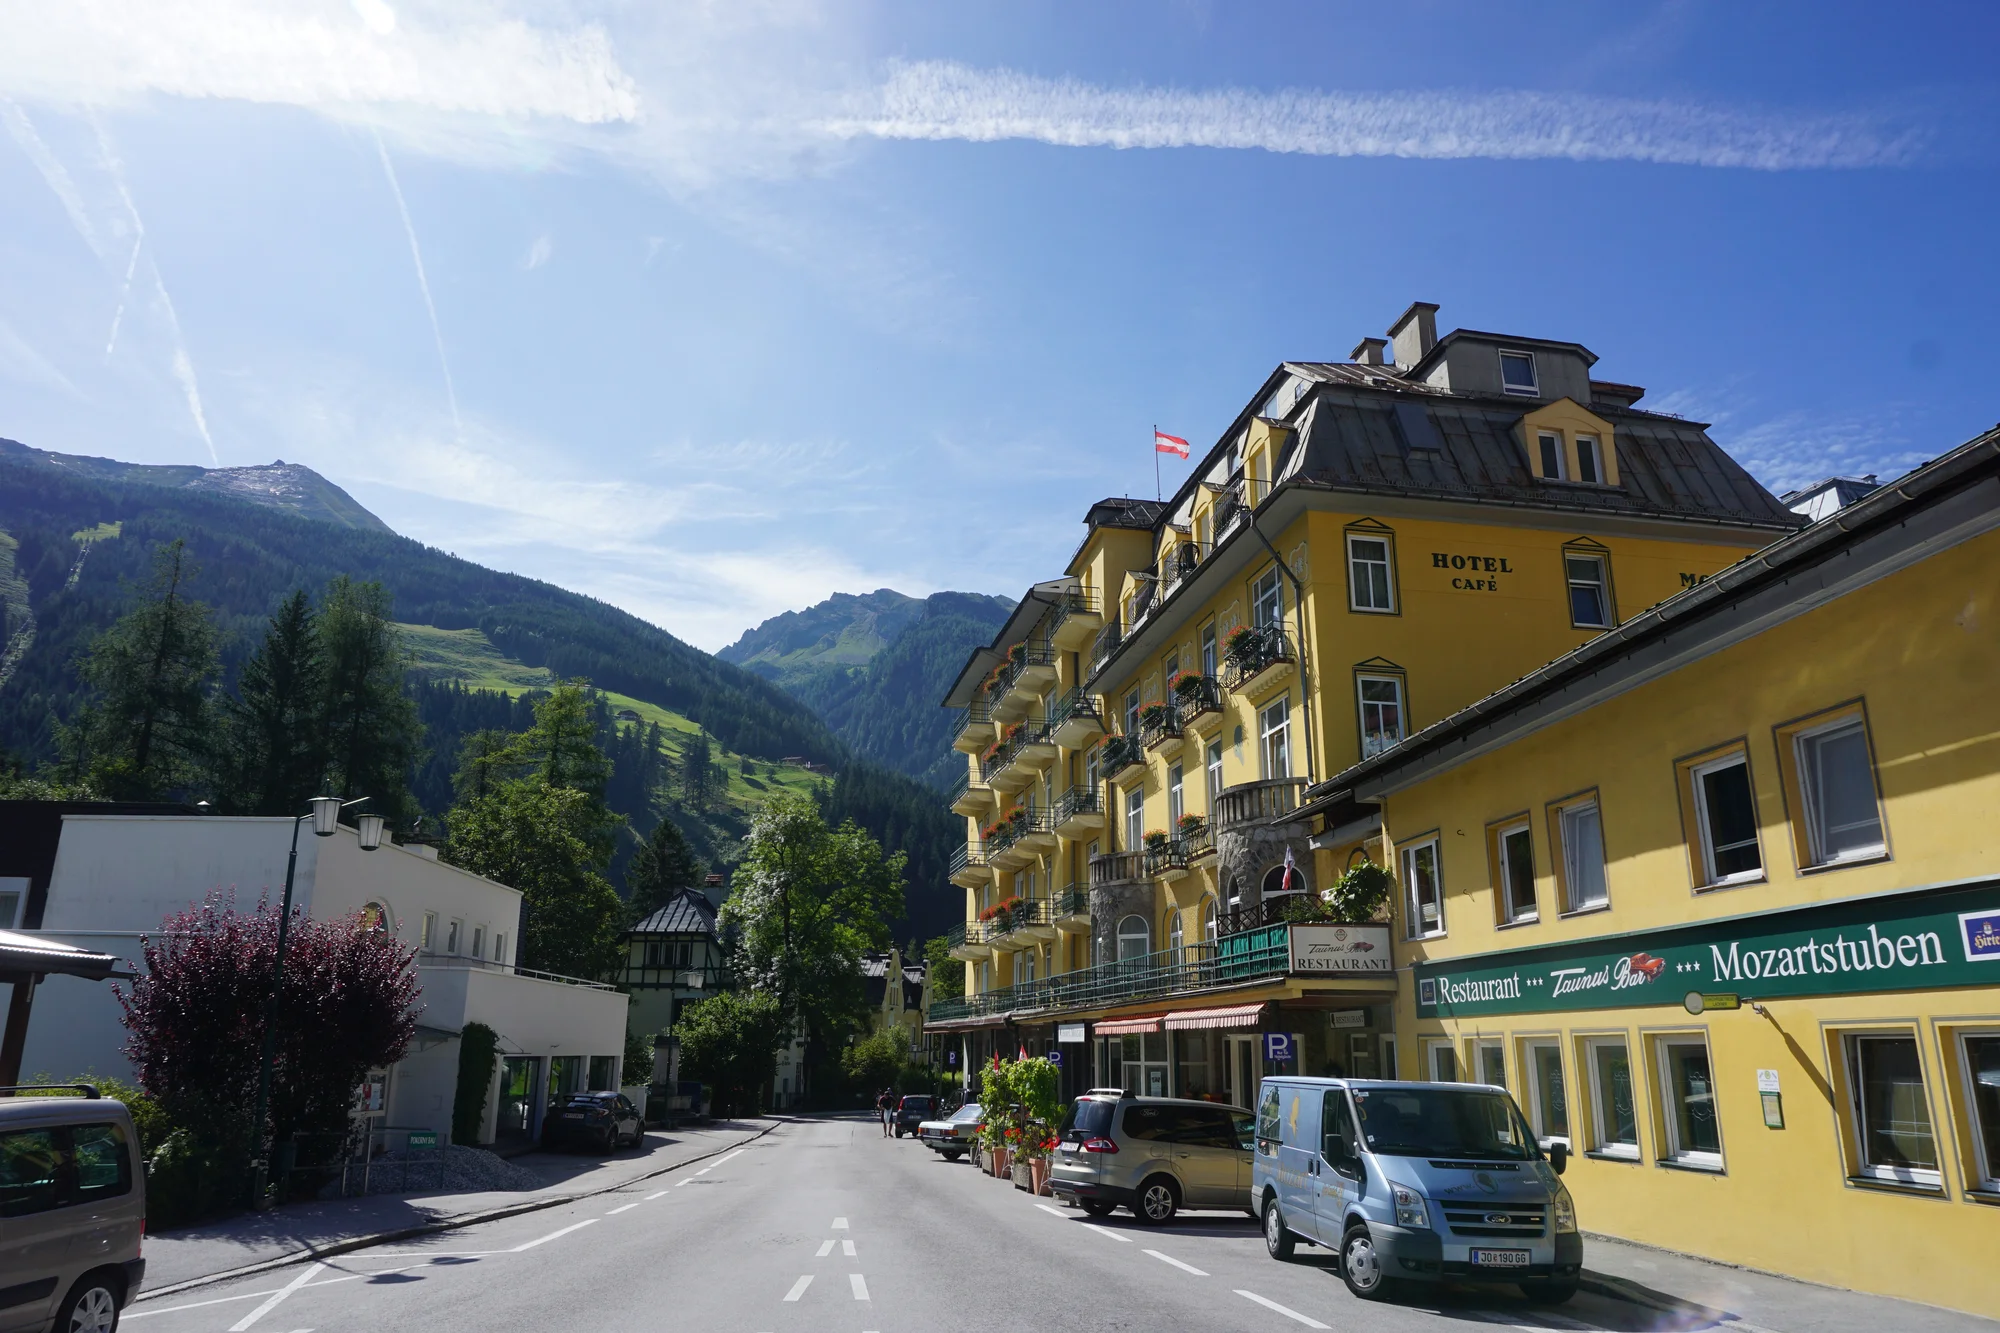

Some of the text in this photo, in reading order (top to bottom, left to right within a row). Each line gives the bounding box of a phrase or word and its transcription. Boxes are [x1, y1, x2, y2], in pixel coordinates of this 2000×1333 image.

[1431, 553, 1513, 573] HOTEL
[1452, 575, 1497, 591] CAFÉ
[1308, 943, 1345, 955] Taunus
[1709, 923, 1947, 982] Mozartstuben
[1297, 958, 1389, 970] RESTAURANT
[1439, 956, 1647, 1004] Restaurant Taunus Bar
[1268, 1033, 1288, 1059] P
[1499, 1252, 1514, 1264] 190
[1515, 1253, 1526, 1264] GG
